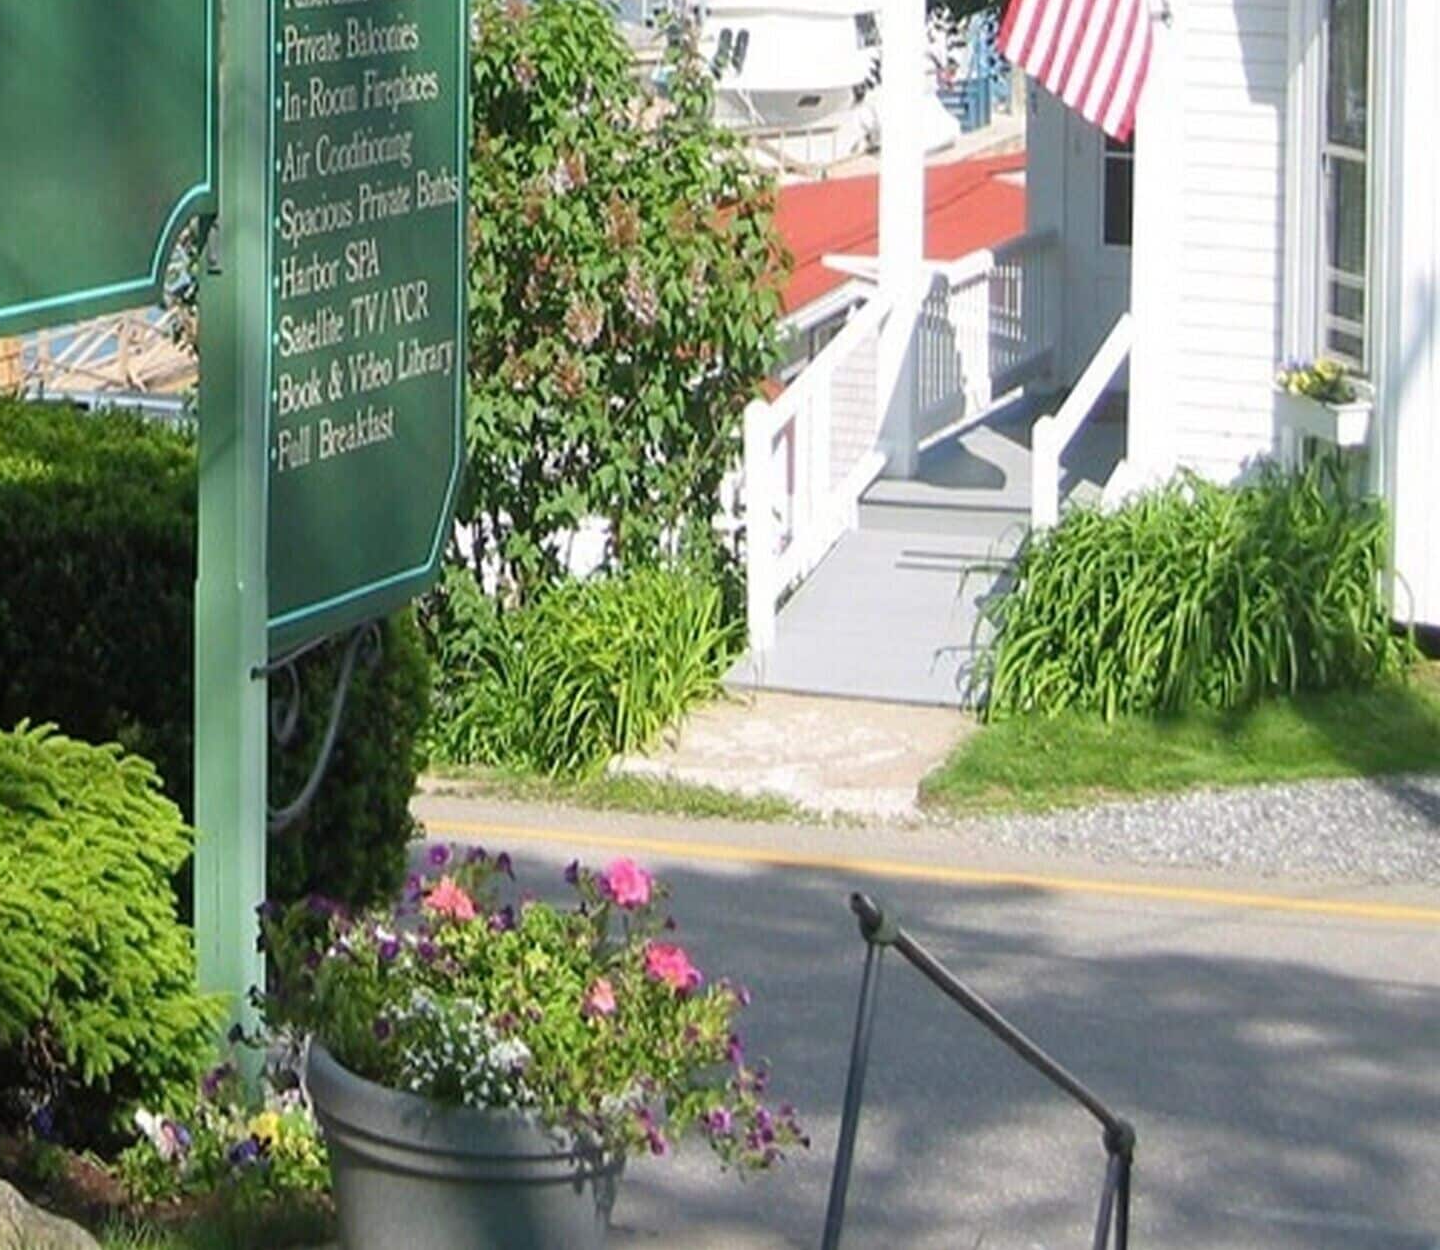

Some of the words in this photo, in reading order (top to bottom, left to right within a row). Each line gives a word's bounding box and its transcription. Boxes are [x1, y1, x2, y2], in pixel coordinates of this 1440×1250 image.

[283, 24, 342, 67] Private
[346, 13, 420, 59] Balconies
[283, 77, 358, 123] In-Room
[363, 66, 439, 113] Fireplaces
[281, 140, 311, 184] Air
[315, 123, 413, 176] Conditioning
[280, 192, 354, 248] Spacious
[358, 179, 411, 224] Private
[416, 170, 460, 210] Baths
[280, 253, 340, 300] Harbor
[344, 237, 381, 283] SPA
[279, 306, 345, 358] Satellite
[278, 368, 323, 417] Book
[327, 359, 344, 402] &
[348, 351, 394, 395] Video
[397, 337, 455, 380] Library
[277, 425, 311, 473] Full
[318, 405, 396, 460] Breakfast
